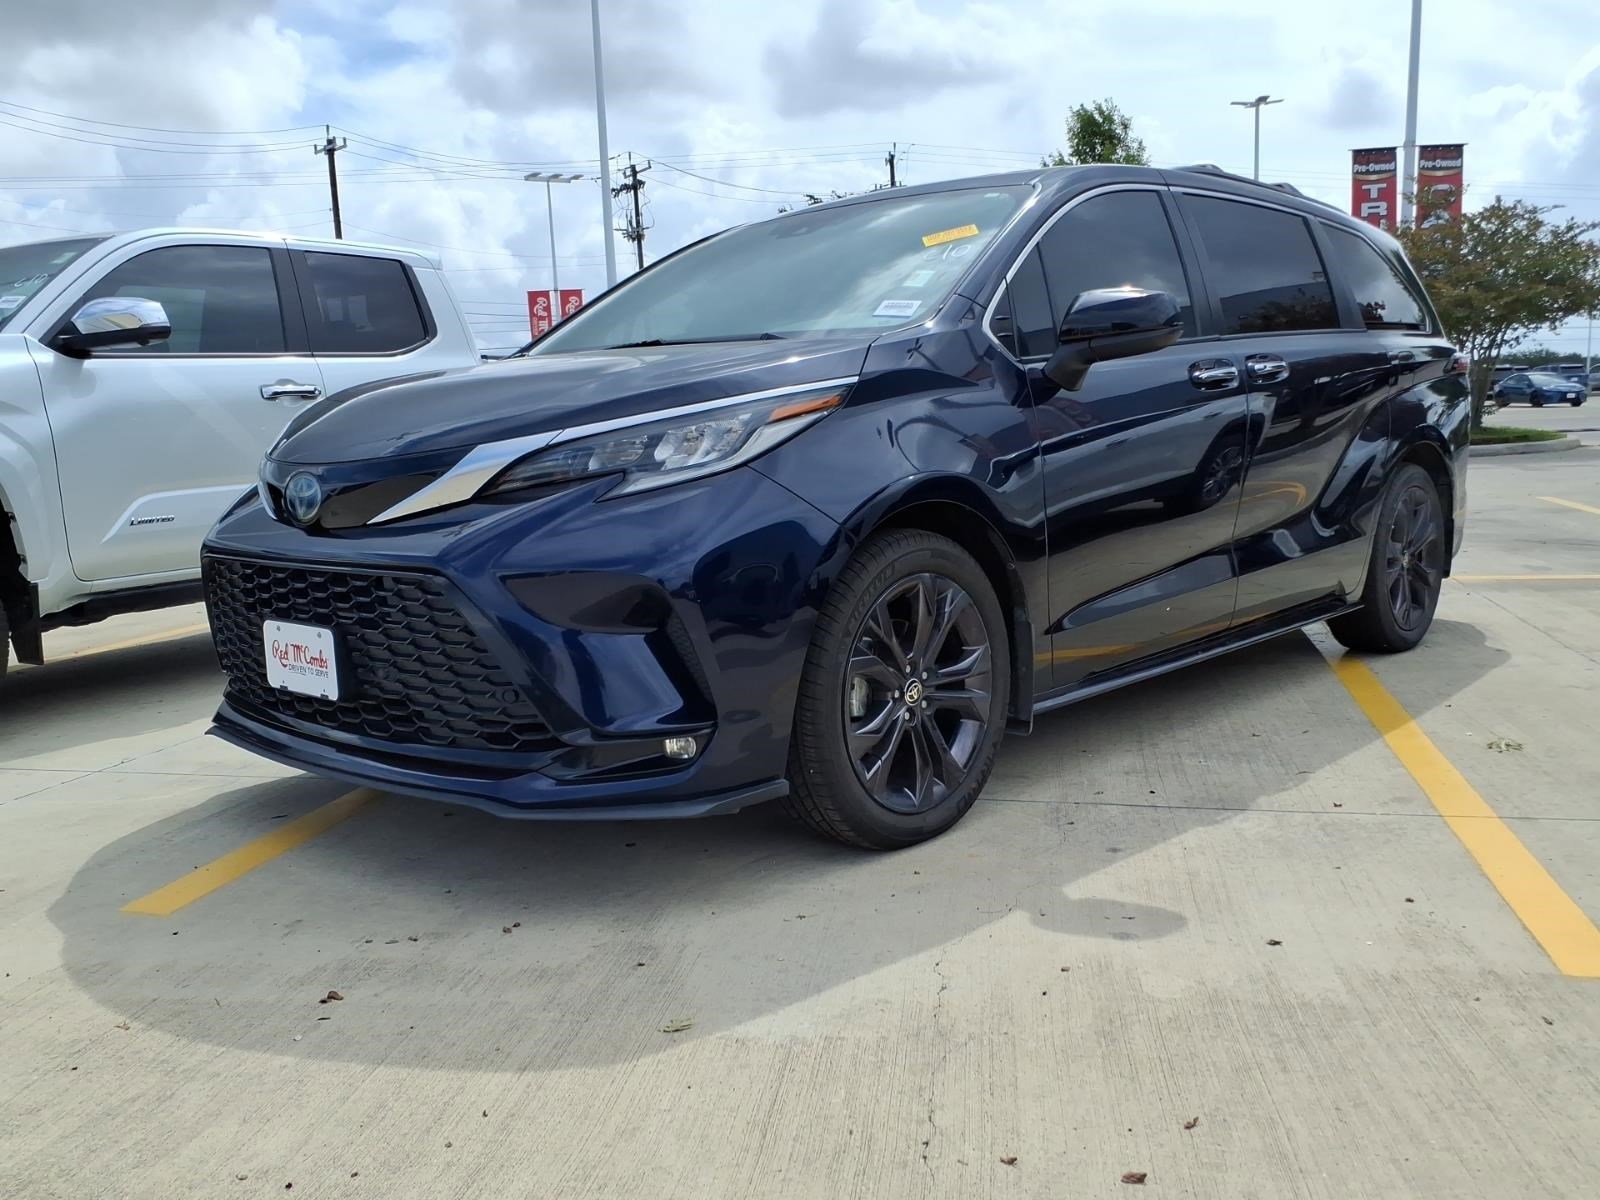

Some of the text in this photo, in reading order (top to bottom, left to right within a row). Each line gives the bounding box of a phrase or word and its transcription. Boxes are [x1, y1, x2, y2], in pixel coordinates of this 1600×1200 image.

[1353, 161, 1396, 173] Pre-Owned
[1419, 158, 1462, 169] Pre-Owned
[272, 639, 329, 670] Red McCombs
[288, 663, 329, 679] DRIVEN TO SERVE
